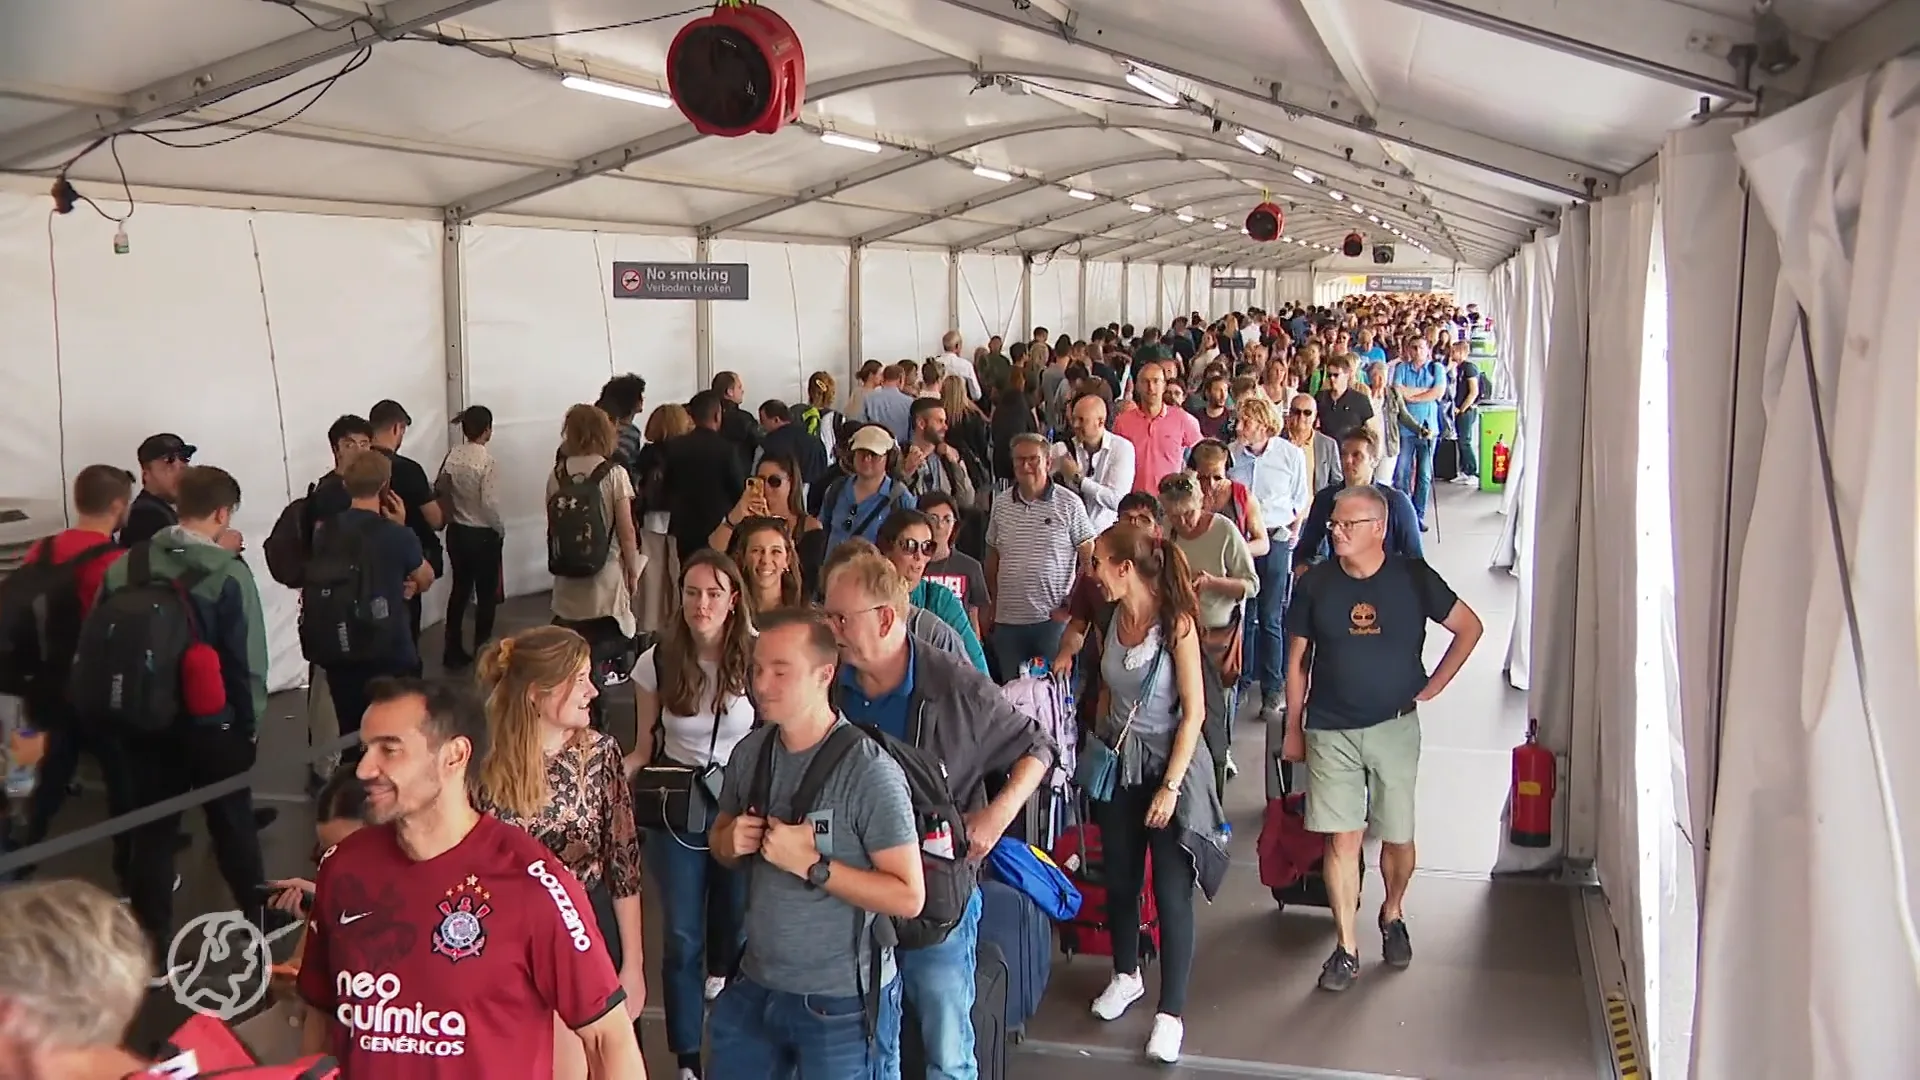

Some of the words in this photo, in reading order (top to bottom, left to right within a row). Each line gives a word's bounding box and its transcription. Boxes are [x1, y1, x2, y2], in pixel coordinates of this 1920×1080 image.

[645, 283, 690, 293] Verboden
[693, 284, 701, 293] te
[704, 283, 731, 293] roken
[646, 267, 666, 280] No
[670, 267, 729, 284] smoking
[527, 859, 592, 952] bozzano
[336, 970, 401, 999] neo
[336, 1000, 466, 1038] química
[359, 1035, 465, 1056] GENÉRICOS
